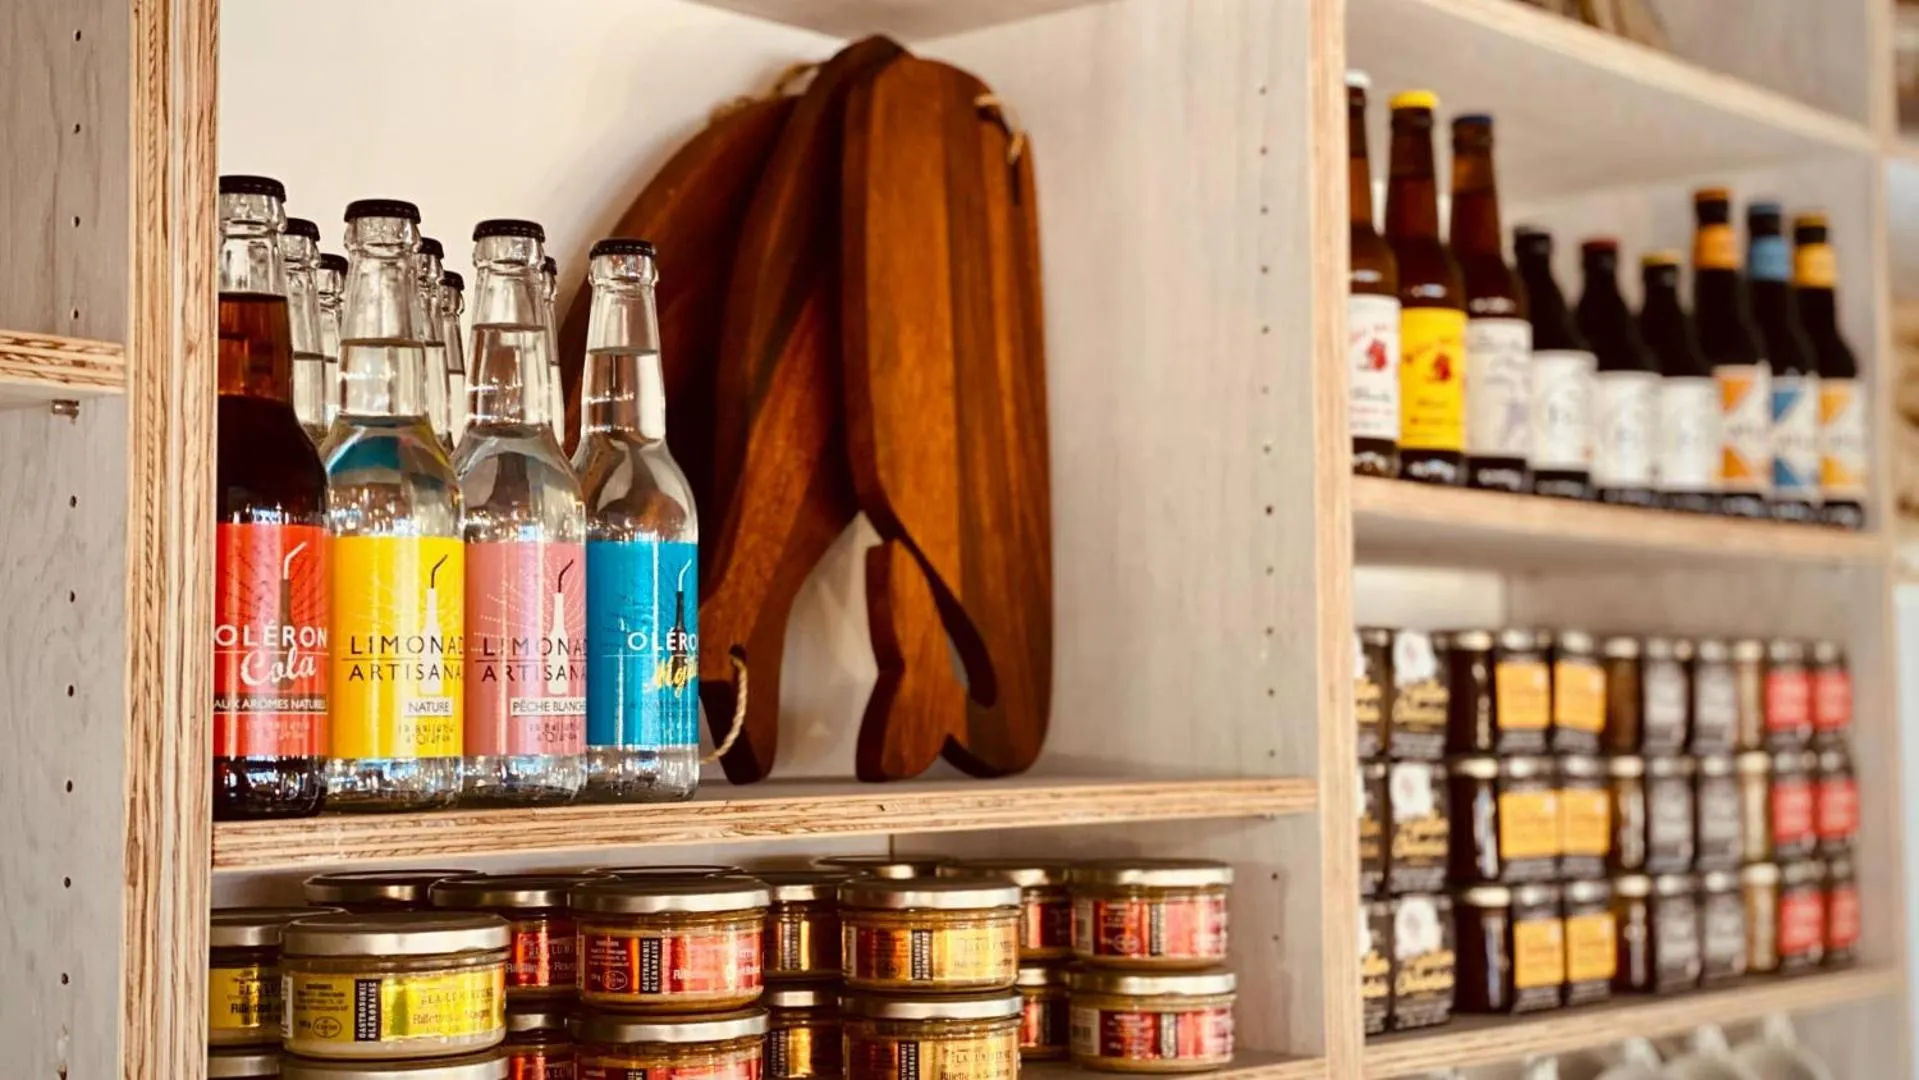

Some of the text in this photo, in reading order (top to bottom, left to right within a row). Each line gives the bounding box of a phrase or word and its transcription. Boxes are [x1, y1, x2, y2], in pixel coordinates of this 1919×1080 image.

[215, 619, 328, 648] OLÉRON
[240, 645, 316, 687] Cola
[214, 698, 239, 710] AUX
[242, 698, 289, 710] AROMES
[408, 700, 450, 713] NATURE
[512, 699, 551, 713] PÊCHE
